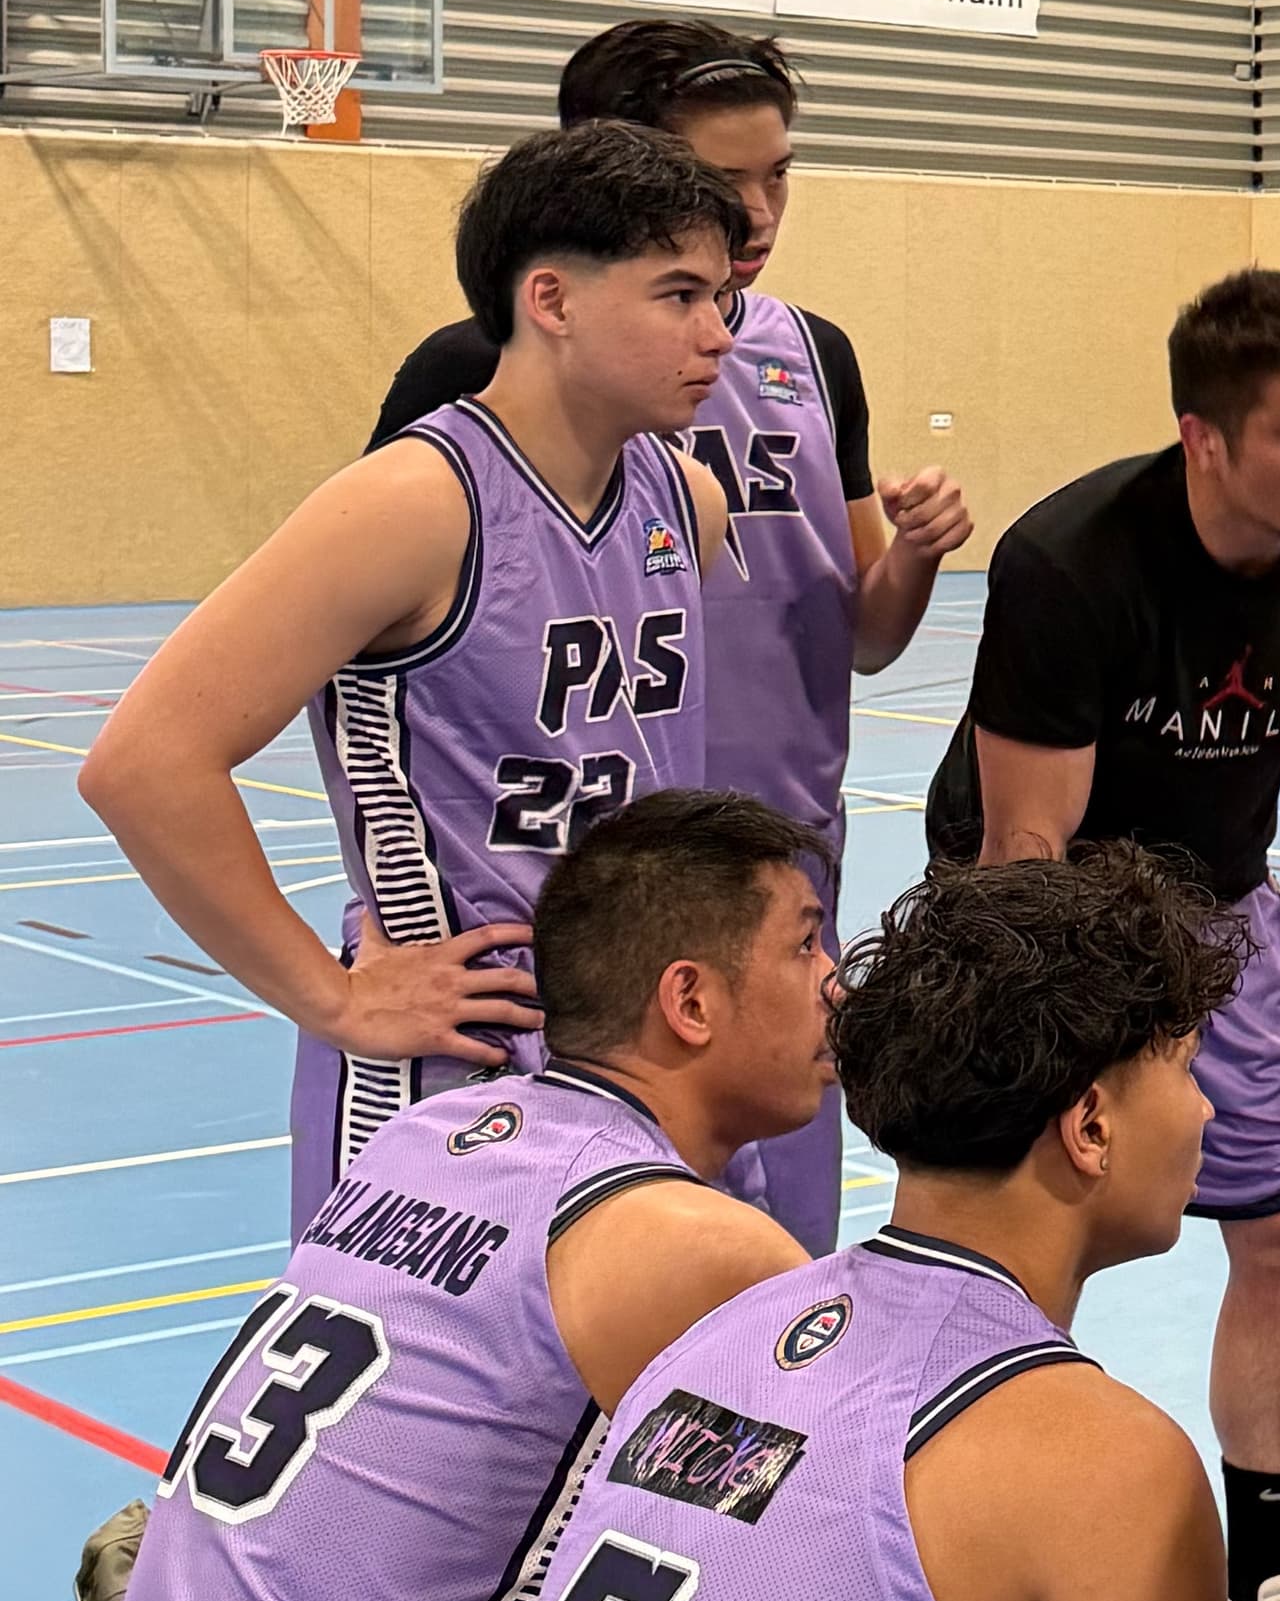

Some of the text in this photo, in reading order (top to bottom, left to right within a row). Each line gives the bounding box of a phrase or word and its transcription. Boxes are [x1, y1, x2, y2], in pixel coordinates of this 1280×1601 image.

[664, 425, 805, 582] AS
[535, 606, 688, 774] PAS
[155, 1282, 392, 1526] 13
